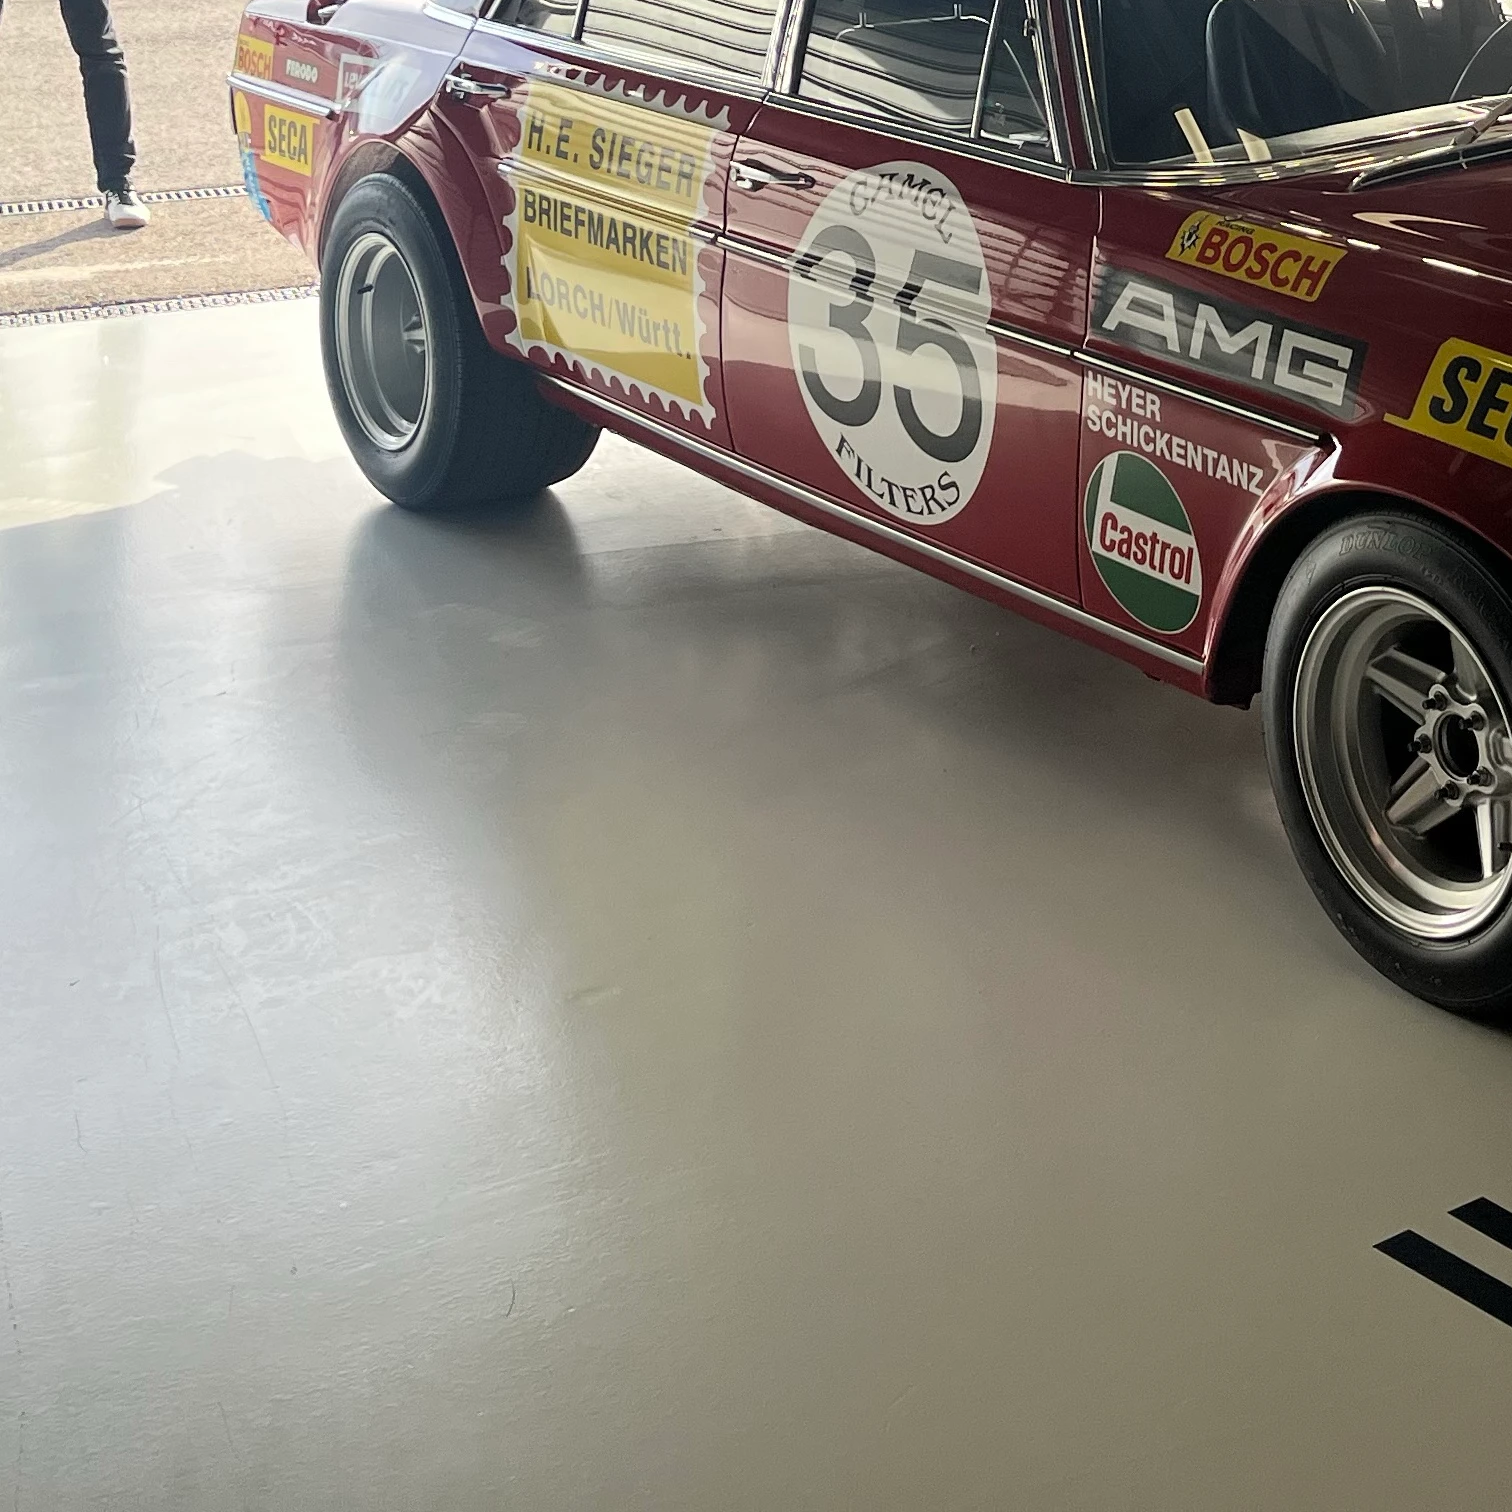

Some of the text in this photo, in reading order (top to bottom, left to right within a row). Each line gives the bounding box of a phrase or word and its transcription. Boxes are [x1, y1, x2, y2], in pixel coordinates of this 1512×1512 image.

[238, 45, 272, 81] BOSCH
[285, 58, 319, 84] FERODO
[268, 113, 309, 166] SECA
[527, 112, 696, 198] H.E. SIEGER
[524, 189, 688, 276] BRIEFMARKEN
[849, 171, 956, 245] CAMEL
[1215, 220, 1255, 236] RACING
[1196, 226, 1331, 297] BOSCH
[795, 224, 983, 463] 35
[1102, 281, 1354, 407] AMG
[1086, 370, 1162, 422] HEYER
[835, 433, 960, 516] FILTERS
[1086, 405, 1266, 497] SCHICKENTANZ
[1100, 511, 1195, 585] Castrol
[1338, 529, 1433, 561] DUNLOP
